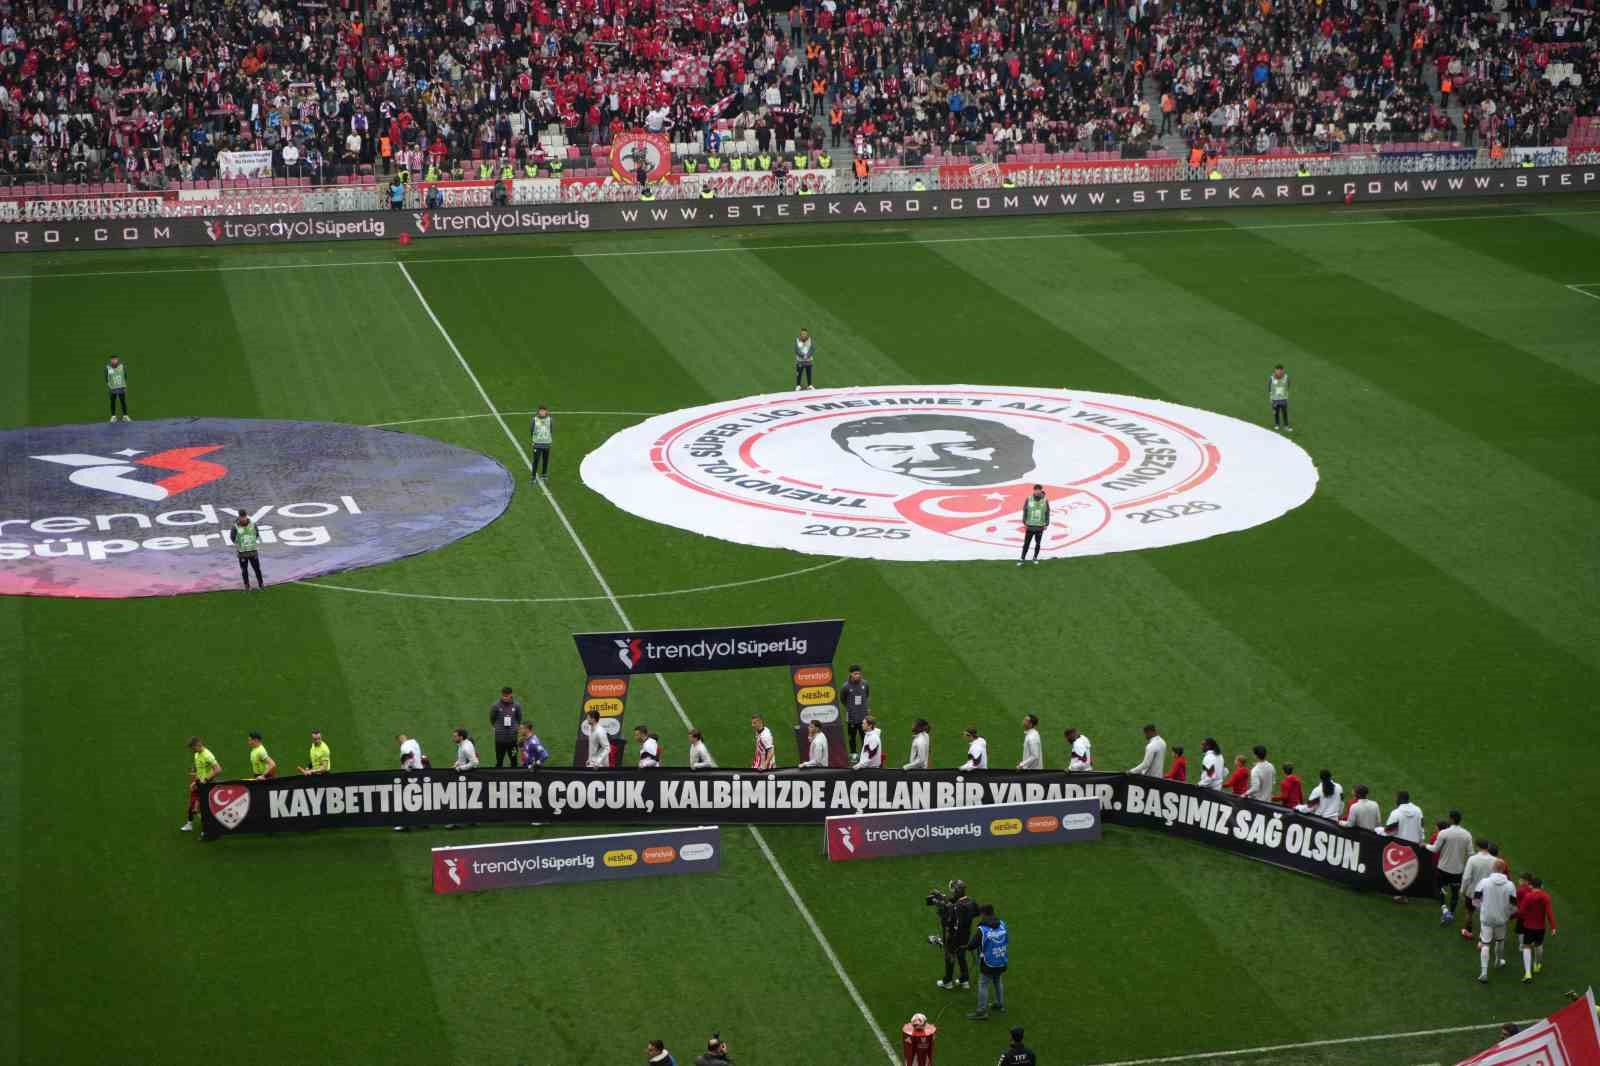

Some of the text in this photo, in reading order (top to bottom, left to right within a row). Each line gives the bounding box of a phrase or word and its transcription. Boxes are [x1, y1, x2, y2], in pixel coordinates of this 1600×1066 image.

[224, 218, 313, 239] trendyol
[432, 210, 519, 231] trendyol
[741, 408, 803, 424] LİG
[804, 397, 994, 413] MEHMET
[683, 423, 752, 458] SÜPER
[1071, 411, 1171, 446] YILMAZ
[1102, 447, 1177, 491] SEZONU
[698, 458, 867, 509] TRENDYOL
[1125, 500, 1222, 524] 2026
[801, 524, 911, 540] 2025
[646, 638, 735, 660] trendyol
[268, 776, 483, 819] KAYBETTİĞİMİZ
[488, 780, 543, 809] HER
[547, 780, 654, 815] ÇOCUK,
[660, 774, 827, 809] KALBİMİZDE
[830, 780, 931, 816] AÇILAN
[936, 776, 985, 808] BİR
[1127, 785, 1232, 835] BAŞIMIZ
[1233, 809, 1283, 848] SAĞ
[1285, 823, 1366, 873] OLSUN.
[866, 825, 930, 842] trendyol
[473, 856, 540, 874] trendyol
